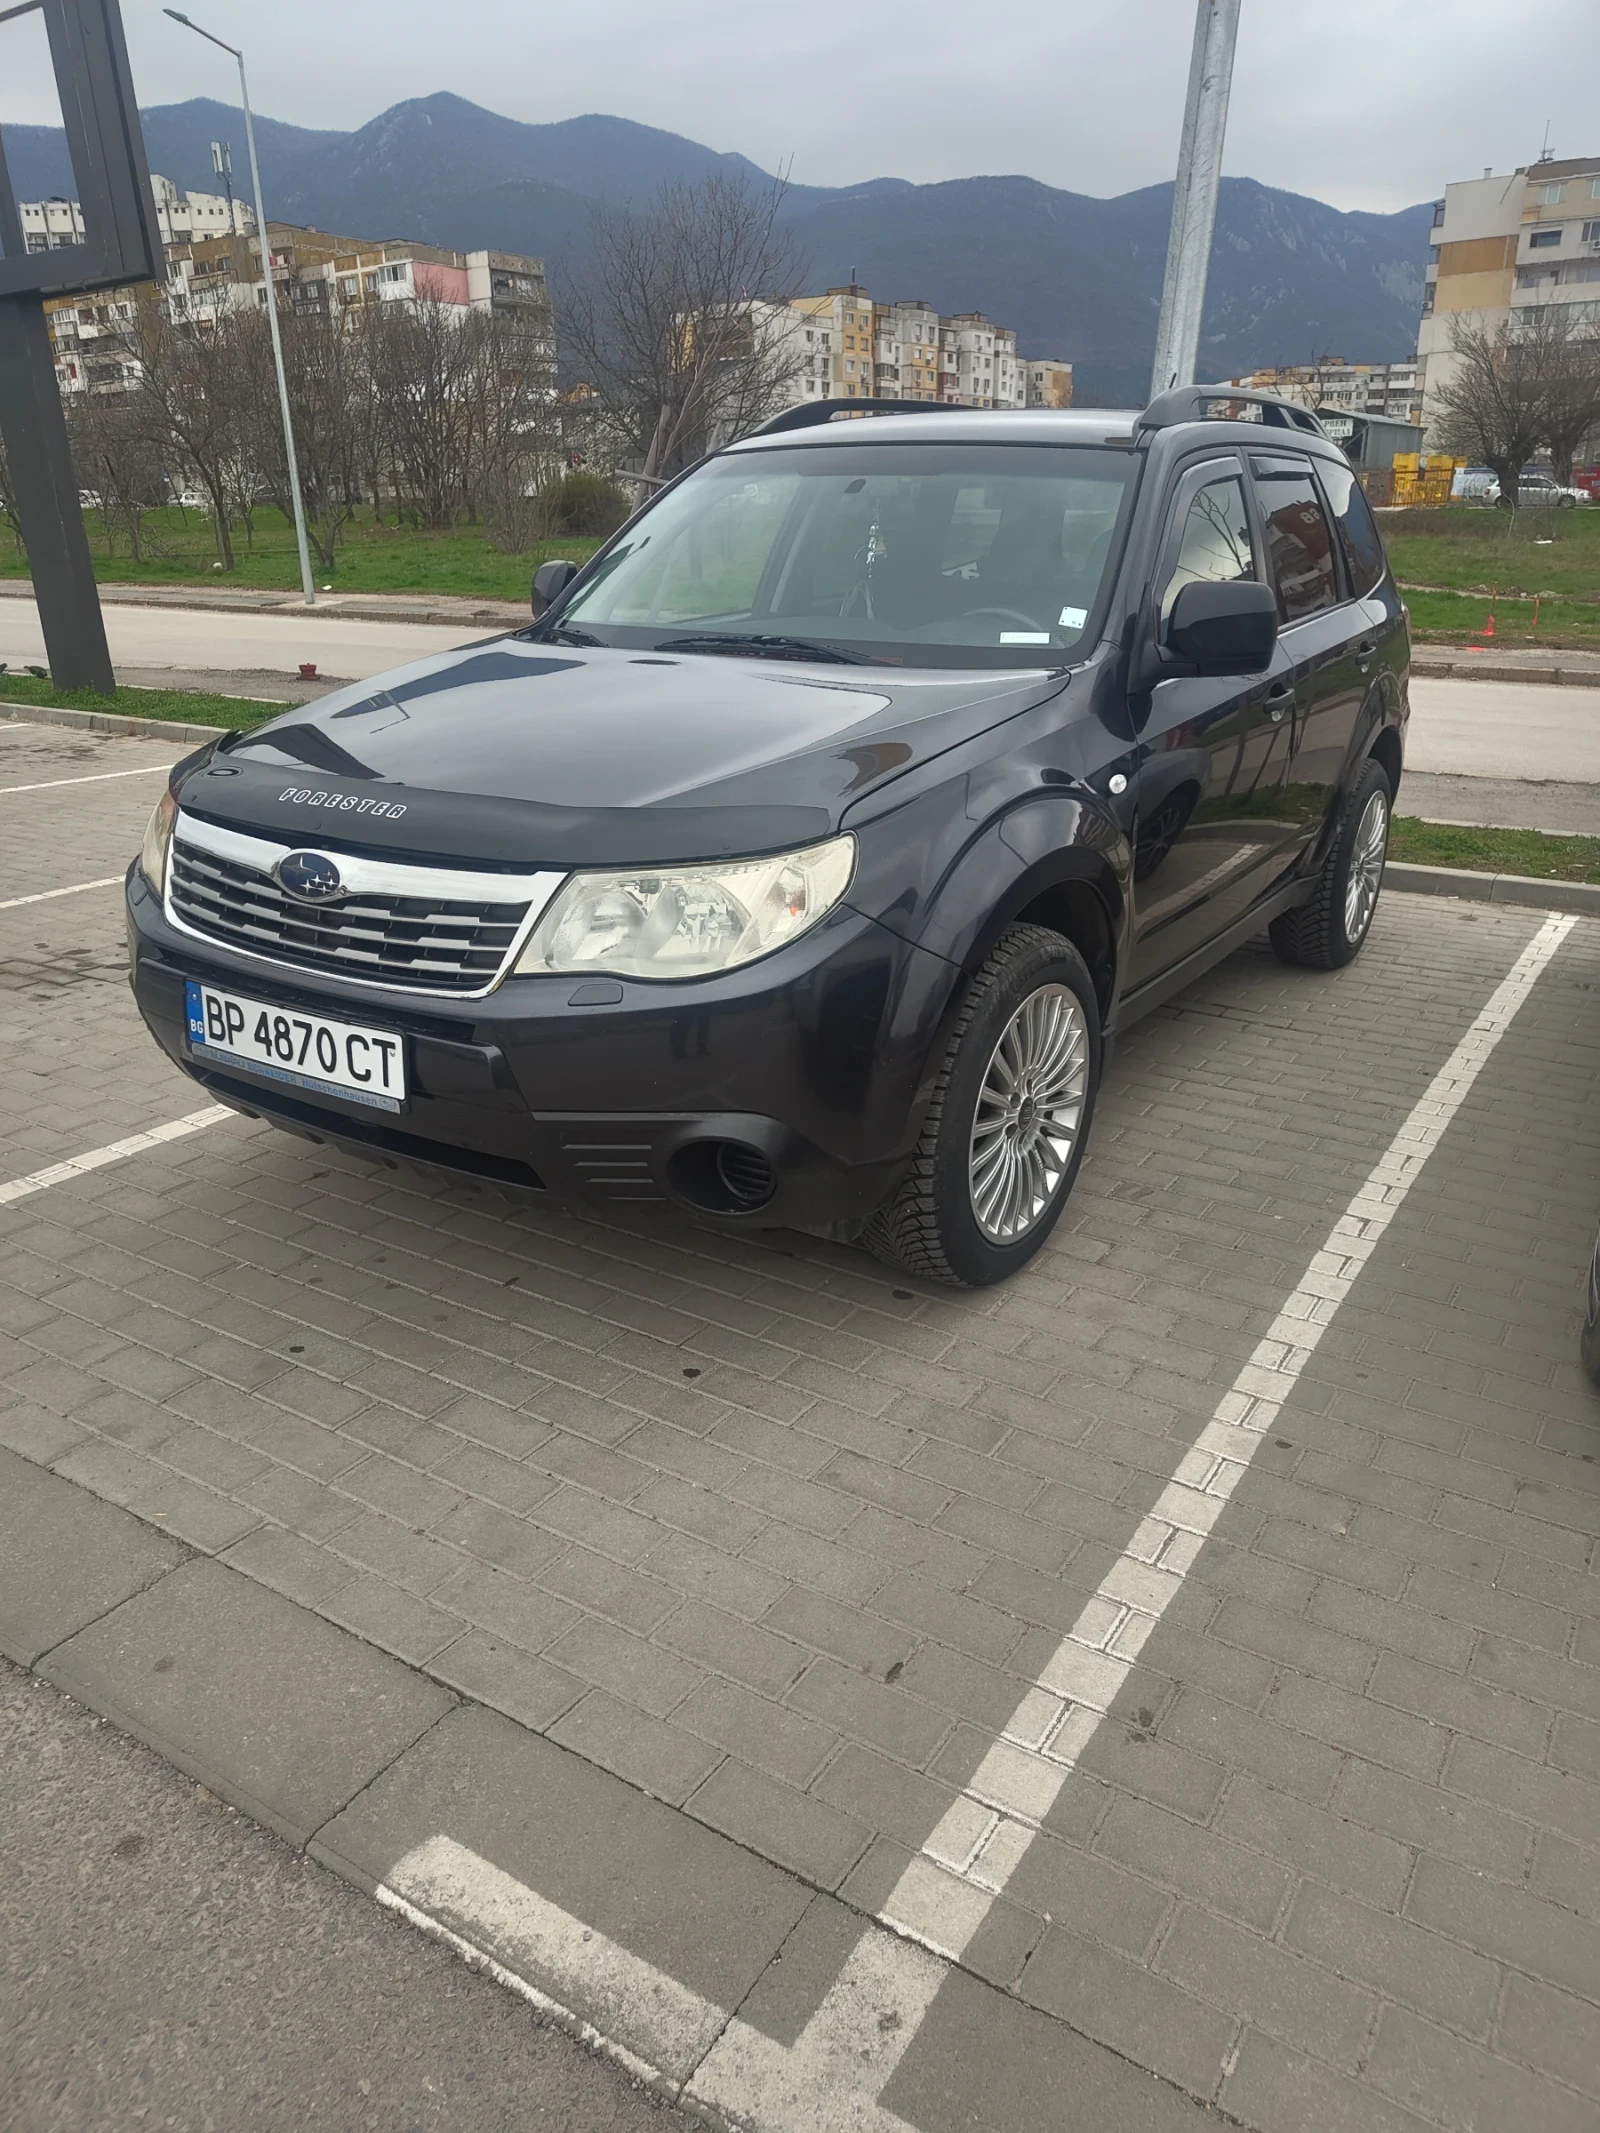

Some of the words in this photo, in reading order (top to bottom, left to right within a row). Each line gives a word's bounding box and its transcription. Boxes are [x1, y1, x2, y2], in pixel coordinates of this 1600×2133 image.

[279, 788, 407, 819] FORESTER
[190, 1018, 204, 1034] BG
[205, 994, 245, 1046] BP
[254, 1011, 337, 1074] 4870
[346, 1033, 396, 1088] CT
[247, 1061, 297, 1084] SCHNEIDER
